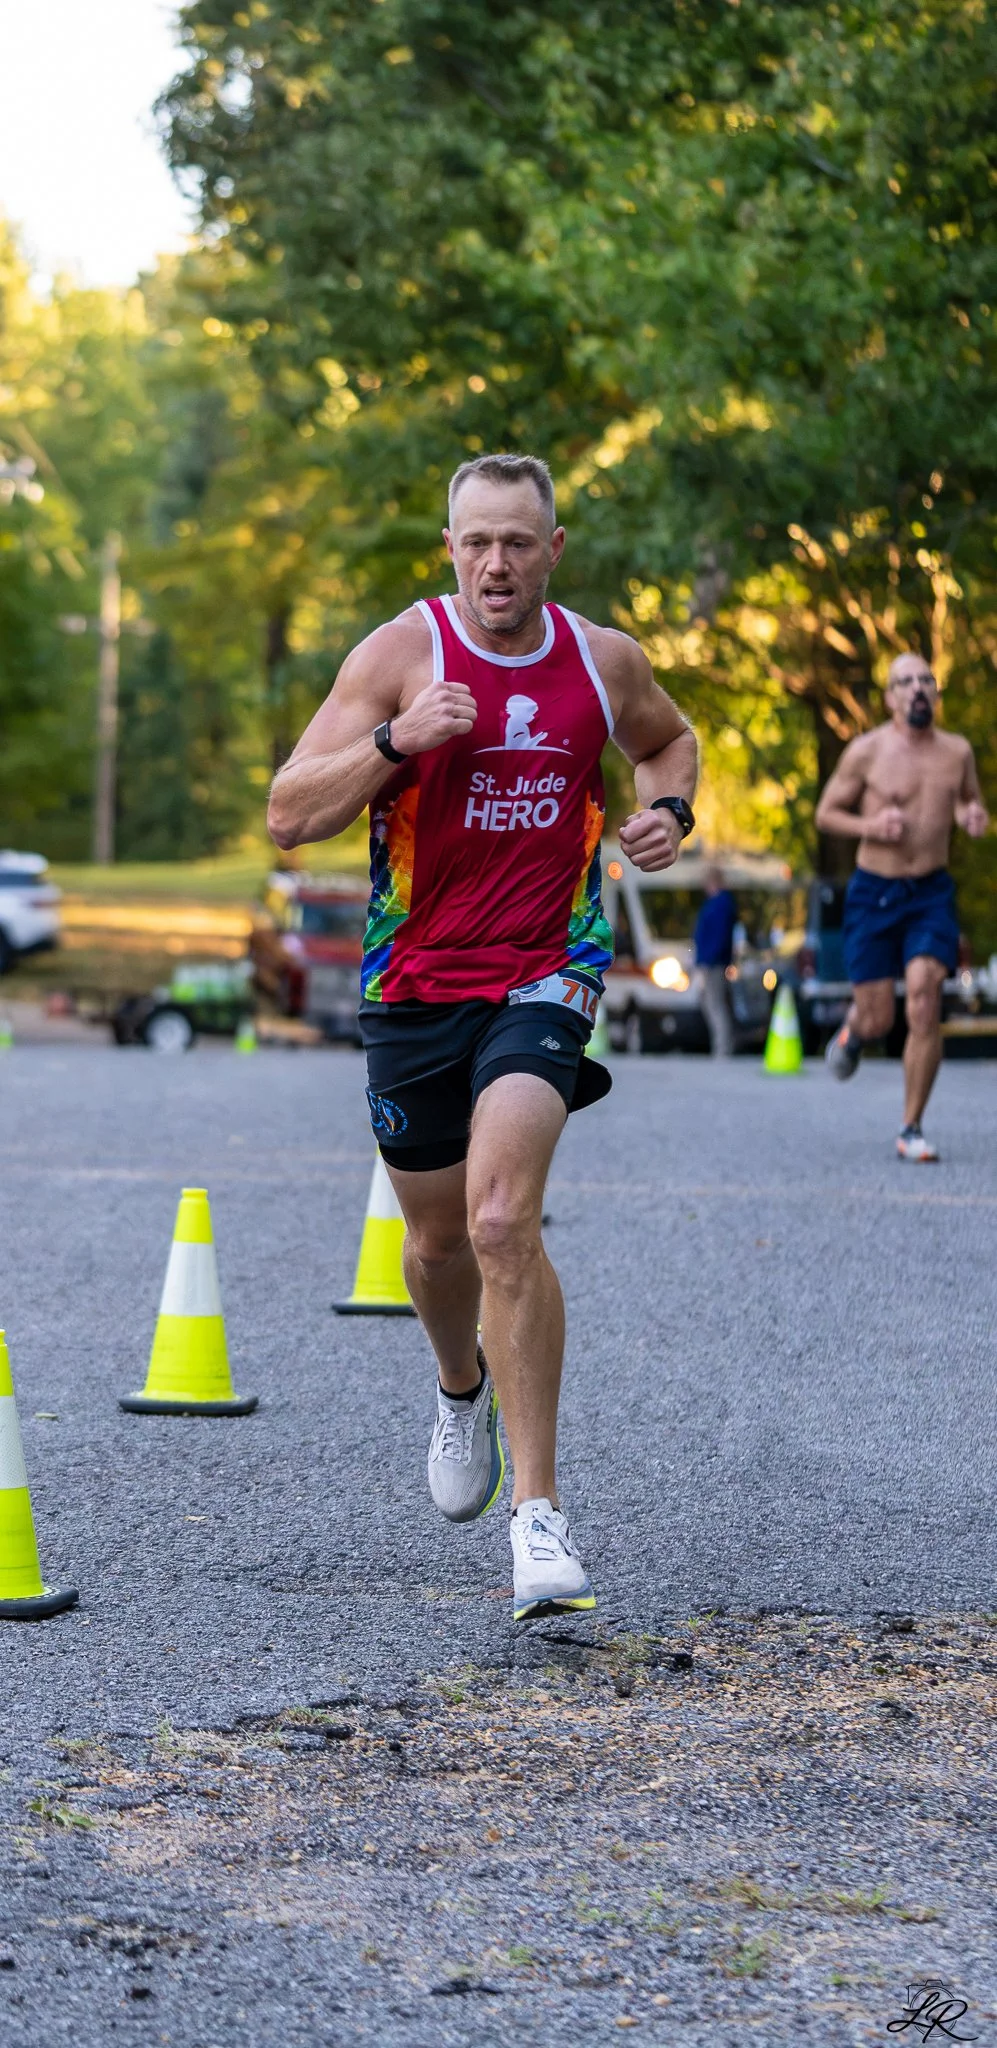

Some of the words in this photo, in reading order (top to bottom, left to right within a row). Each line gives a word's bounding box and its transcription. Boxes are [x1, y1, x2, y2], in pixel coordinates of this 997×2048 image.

[469, 772, 501, 796] St.
[506, 772, 567, 797] Jude
[464, 797, 560, 832] HERO
